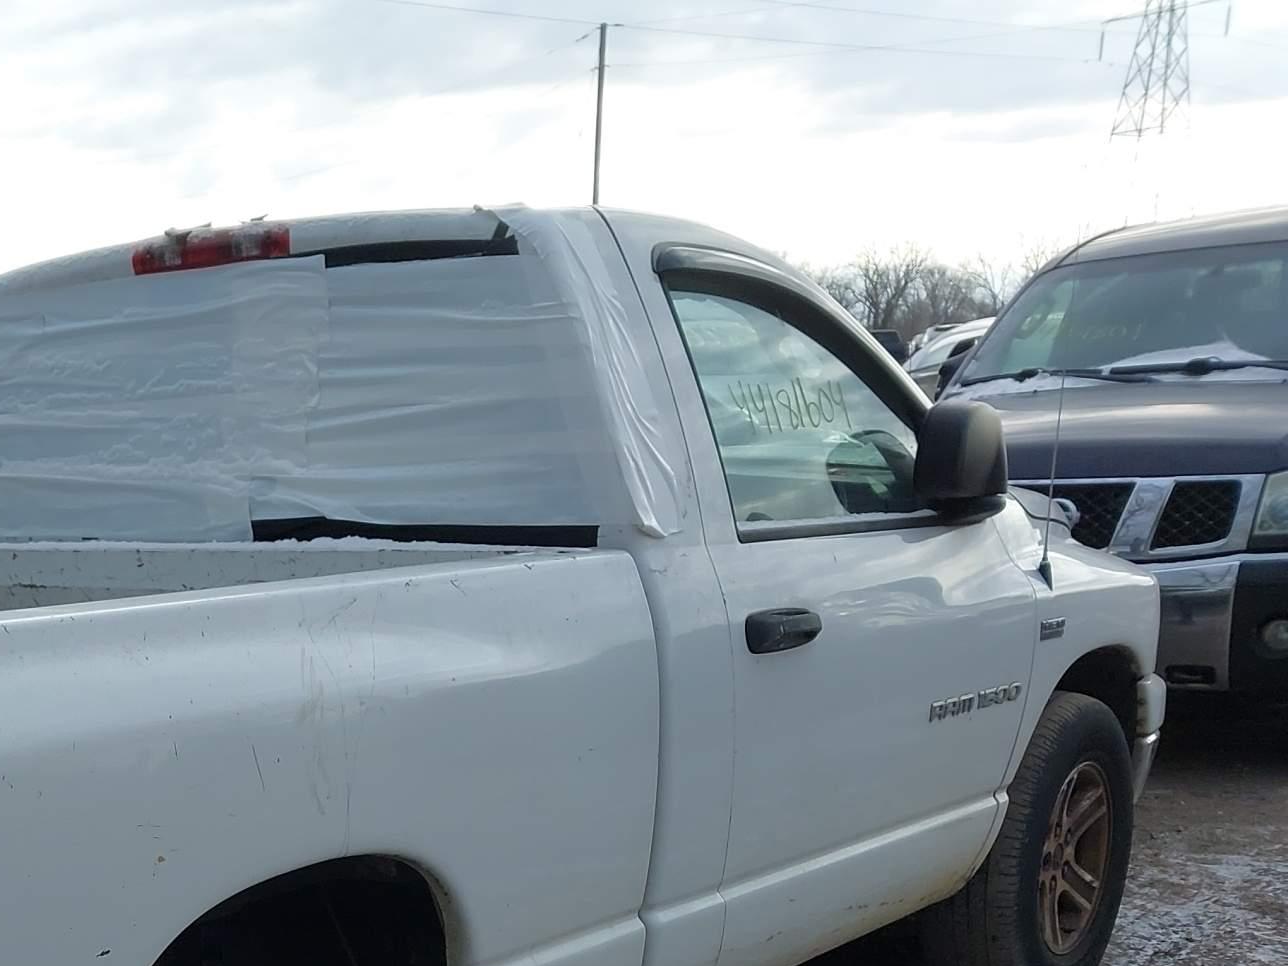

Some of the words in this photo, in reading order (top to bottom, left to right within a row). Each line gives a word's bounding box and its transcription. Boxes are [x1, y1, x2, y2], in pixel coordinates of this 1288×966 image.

[727, 377, 852, 435] 44181604
[929, 693, 975, 722] RAM
[976, 681, 1022, 710] 1500
